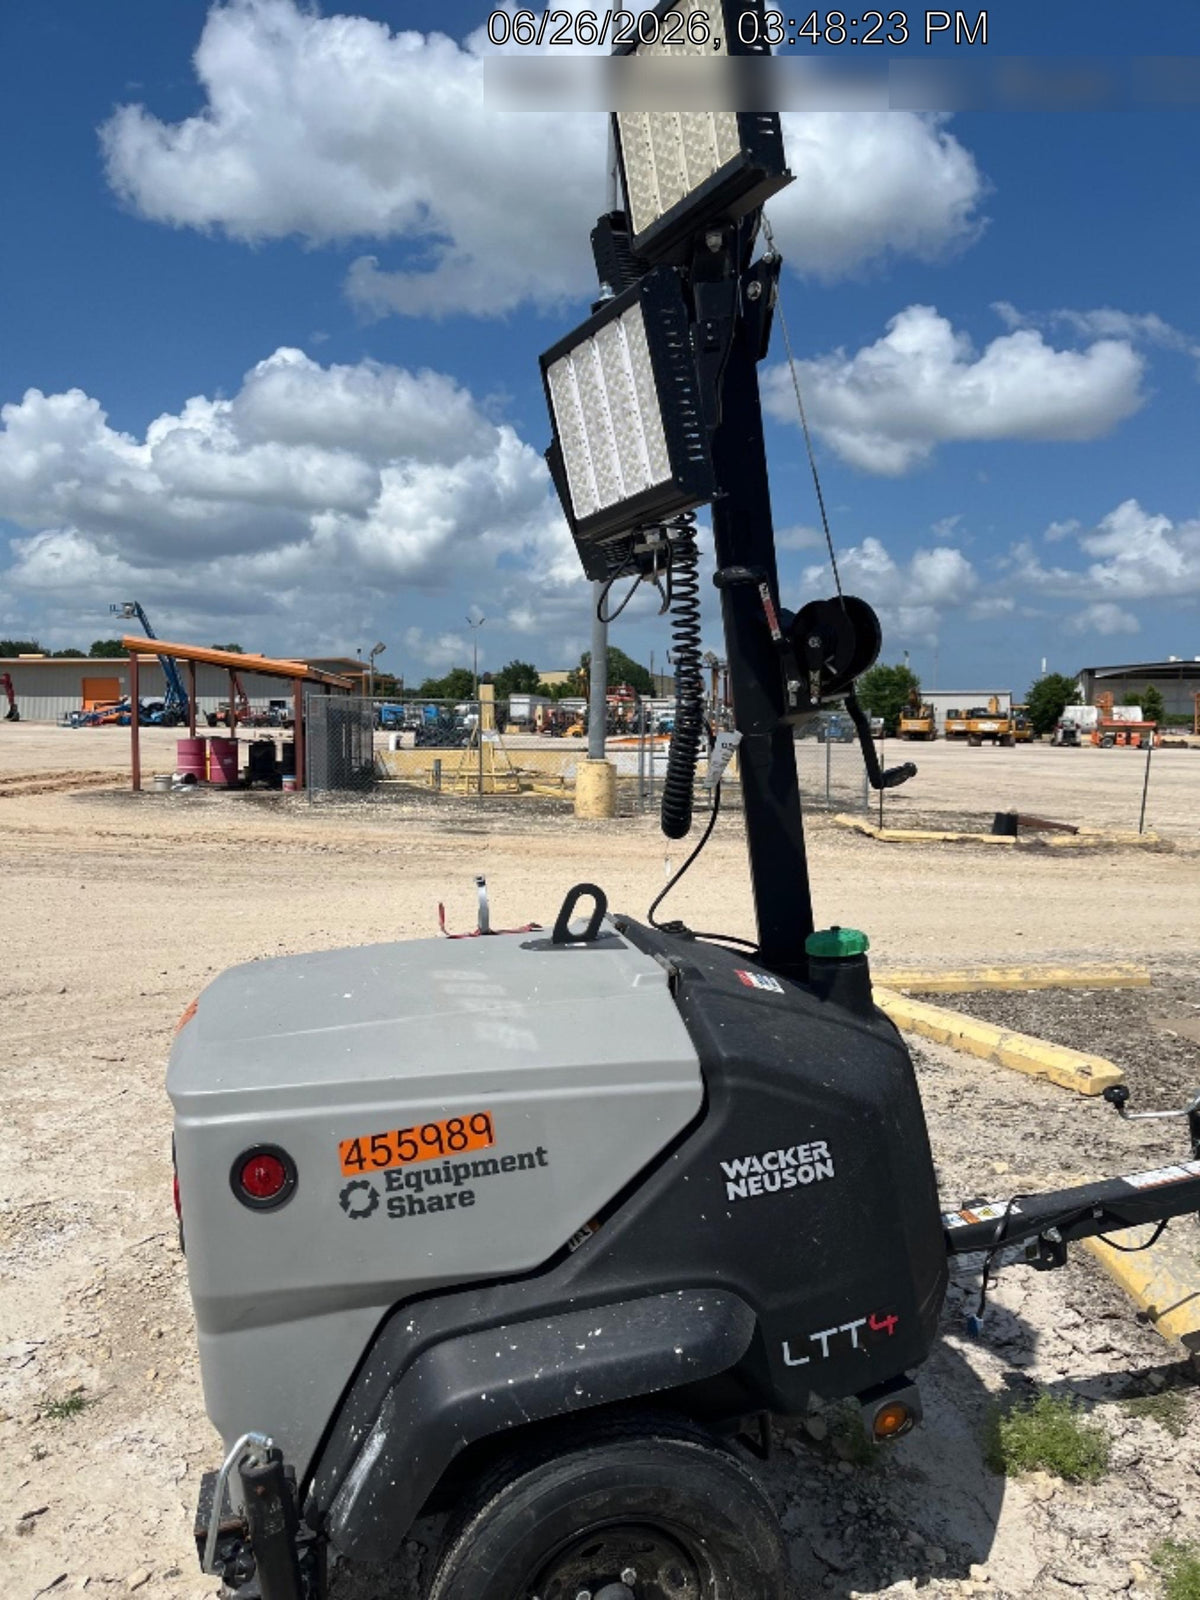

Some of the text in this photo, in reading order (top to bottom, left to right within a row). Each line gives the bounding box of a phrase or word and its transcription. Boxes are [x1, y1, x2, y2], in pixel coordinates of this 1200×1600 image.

[344, 1112, 494, 1171] 455989
[720, 1140, 831, 1180] WACKER
[384, 1146, 549, 1193] Equipment
[726, 1158, 835, 1201] NEUSON
[386, 1188, 476, 1220] Share
